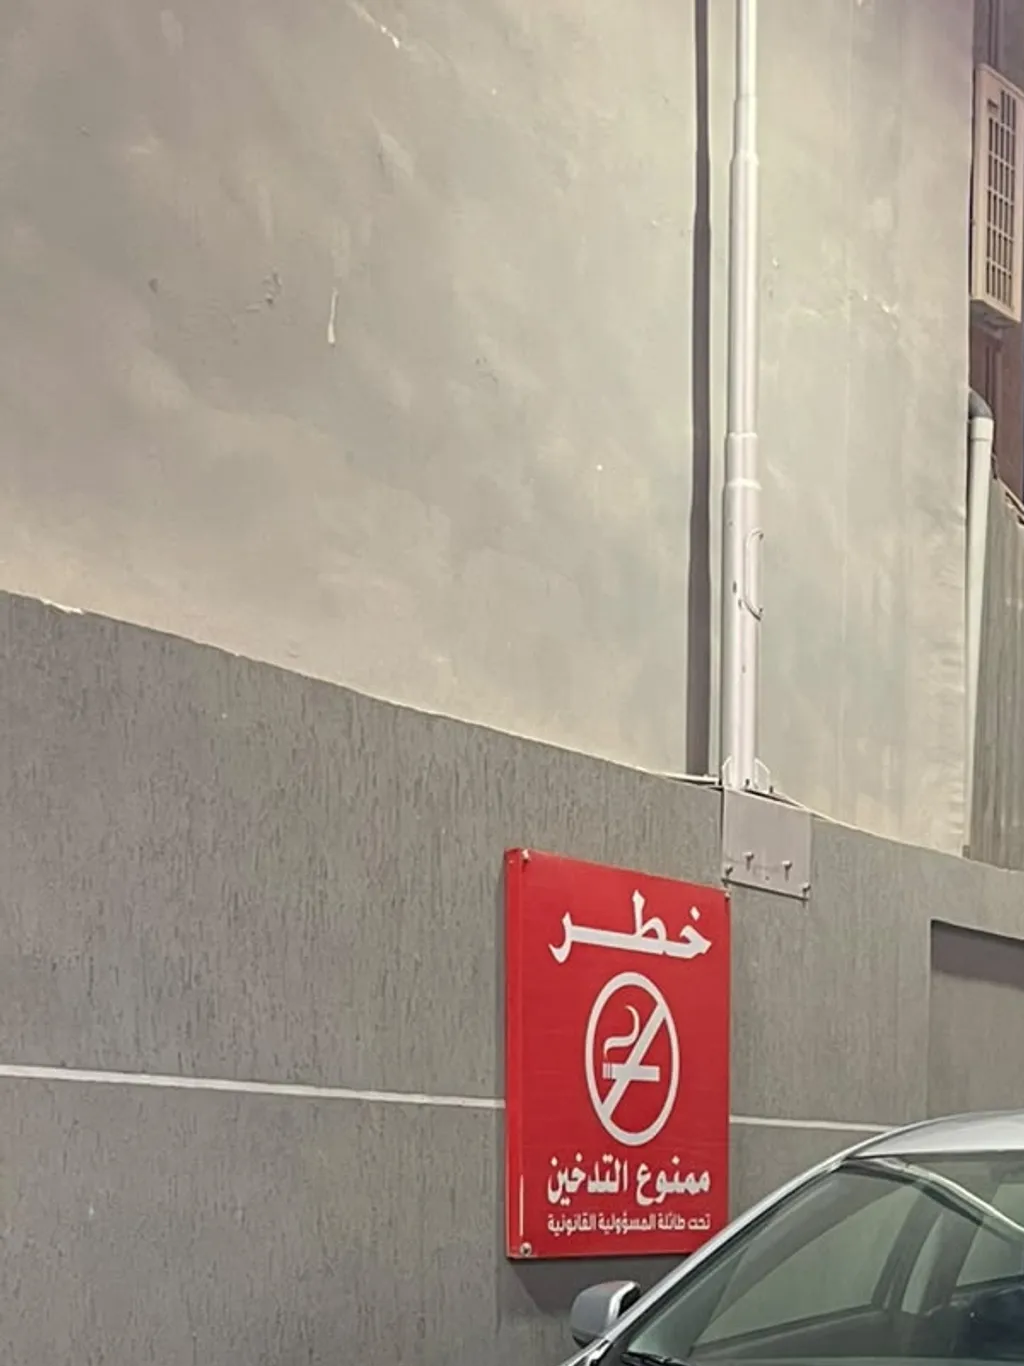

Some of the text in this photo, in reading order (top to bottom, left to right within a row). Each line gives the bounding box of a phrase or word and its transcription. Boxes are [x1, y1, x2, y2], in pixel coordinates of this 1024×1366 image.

[549, 889, 712, 963] خطر
[547, 1152, 711, 1206] ممنوع التدخين
[547, 1211, 711, 1237] تحت طائلة المسؤولية القانونية
